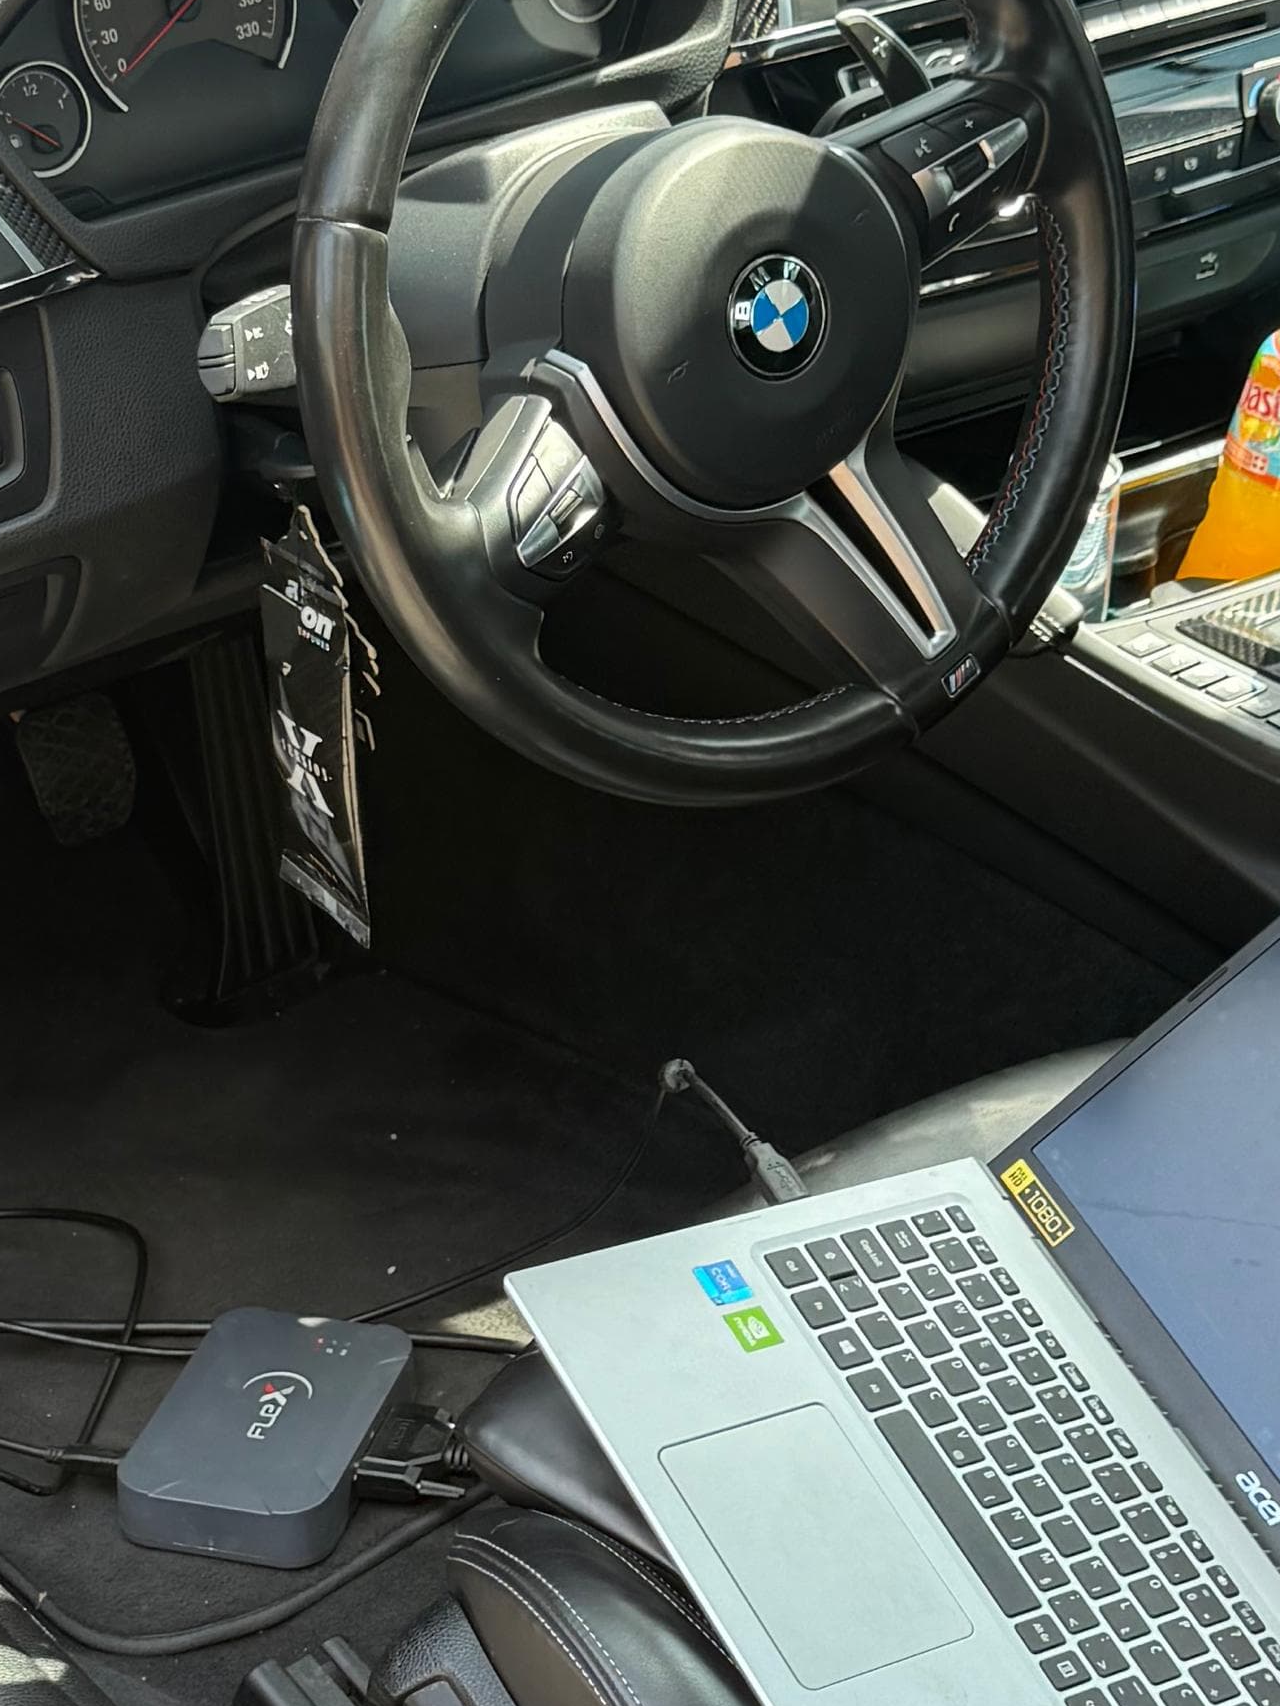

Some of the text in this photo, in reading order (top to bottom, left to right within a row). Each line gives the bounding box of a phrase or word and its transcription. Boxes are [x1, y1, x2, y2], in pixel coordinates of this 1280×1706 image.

[235, 21, 260, 40] 330
[100, 28, 118, 45] 30
[117, 58, 127, 73] 0
[22, 83, 39, 97] 1/2
[734, 260, 801, 330] BMW
[1008, 1171, 1024, 1187] HD
[1027, 1190, 1062, 1233] 1080
[927, 1266, 939, 1276] Q
[897, 1286, 910, 1295] A
[953, 1302, 969, 1314] W
[876, 1314, 889, 1322] Y
[924, 1321, 937, 1331] S
[979, 1337, 992, 1349] E
[901, 1352, 915, 1363] X
[950, 1360, 964, 1369] D
[1006, 1375, 1019, 1387] R
[929, 1390, 942, 1401] C
[977, 1395, 990, 1406] F
[956, 1430, 970, 1438] V
[1006, 1438, 1019, 1449] G
[1061, 1457, 1075, 1466] Z
[983, 1470, 996, 1479] B
[1032, 1477, 1046, 1488] H
[1090, 1496, 1104, 1506] U
[1010, 1510, 1025, 1521] N
[1039, 1552, 1055, 1565] M
[1089, 1559, 1103, 1570] K
[1148, 1575, 1162, 1590] O
[1119, 1601, 1131, 1611] L
[1178, 1620, 1191, 1628] P
